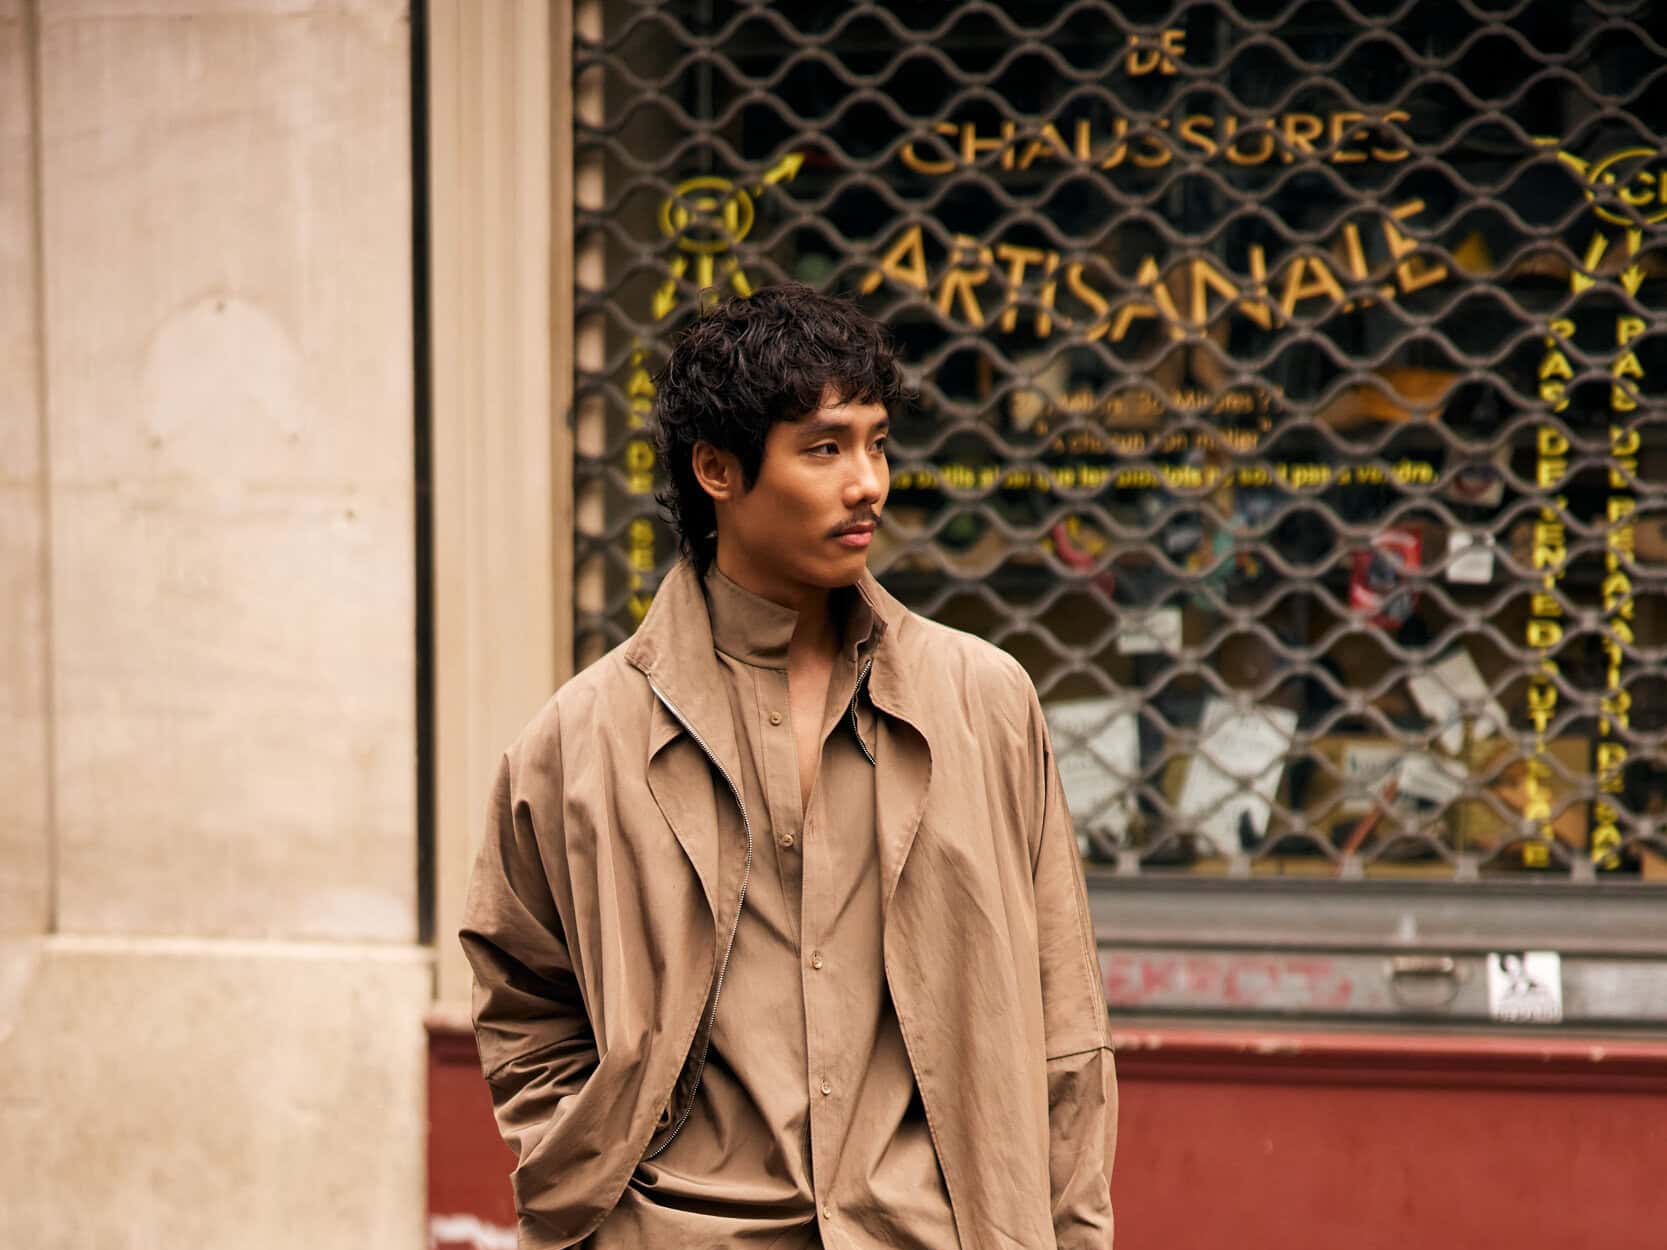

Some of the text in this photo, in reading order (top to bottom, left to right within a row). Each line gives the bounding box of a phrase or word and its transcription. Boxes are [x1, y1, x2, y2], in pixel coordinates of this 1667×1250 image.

[1126, 29, 1187, 75] DE
[902, 110, 1411, 174] CHAUSSURES
[861, 198, 1449, 342] ARTISANALE
[1539, 318, 1576, 413] PAS
[1611, 316, 1647, 412] PAS
[1536, 426, 1571, 490] DE
[1609, 423, 1641, 490] DE
